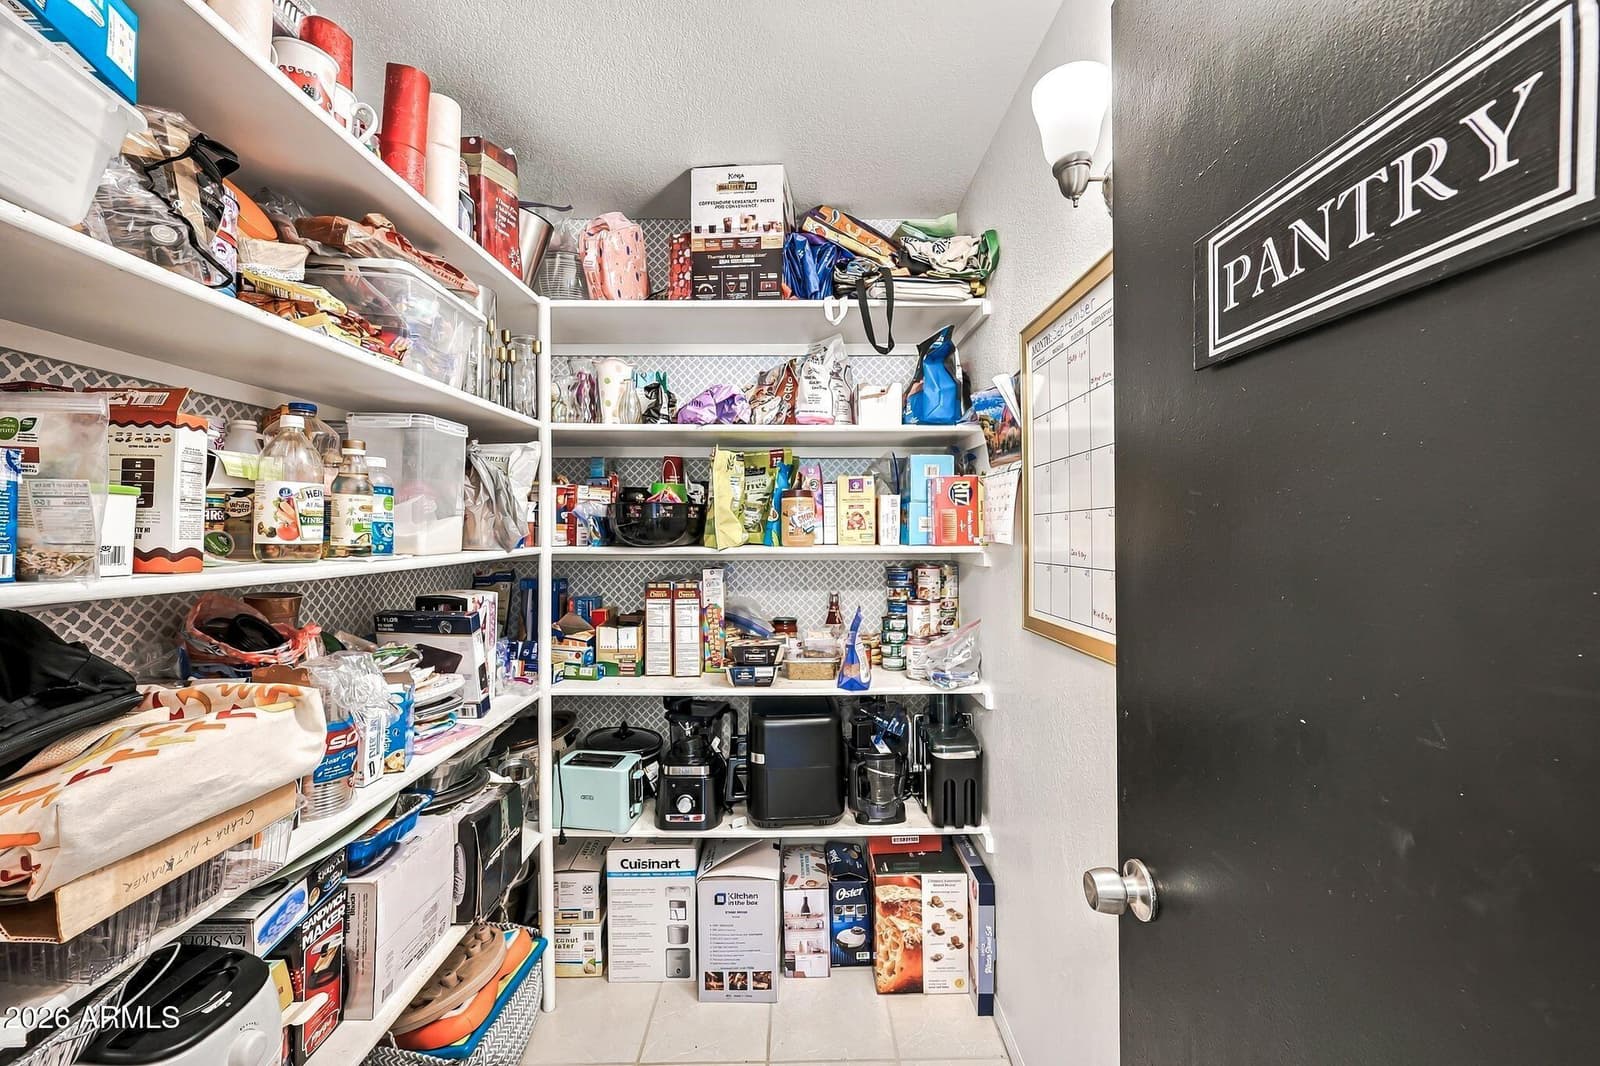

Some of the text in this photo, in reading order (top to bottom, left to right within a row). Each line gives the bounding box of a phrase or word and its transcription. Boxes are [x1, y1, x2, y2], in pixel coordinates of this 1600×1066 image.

[1223, 71, 1543, 312] PANTRY
[953, 481, 971, 506] RITZ
[215, 809, 255, 838] CLARA
[620, 858, 681, 870] Cuisinart
[727, 892, 759, 900] Kitchen
[836, 887, 864, 901] Oster
[302, 889, 347, 933] SANDWICH
[302, 904, 346, 950] MAKER
[225, 935, 246, 948] Icy
